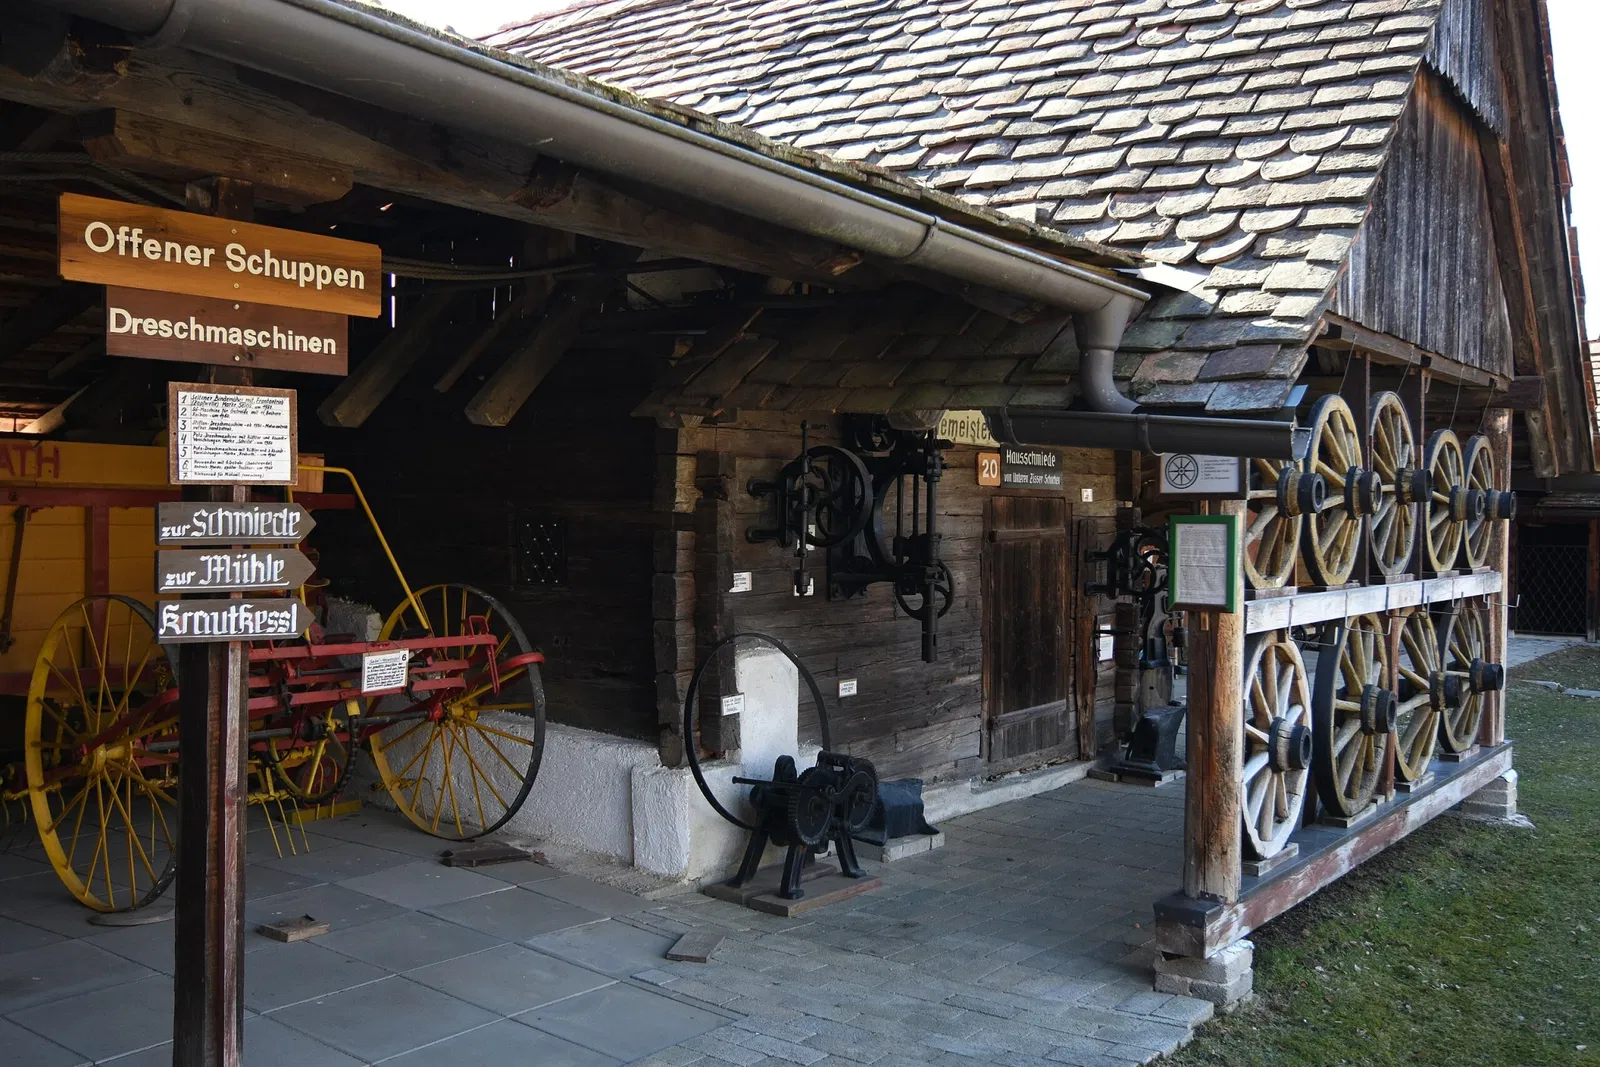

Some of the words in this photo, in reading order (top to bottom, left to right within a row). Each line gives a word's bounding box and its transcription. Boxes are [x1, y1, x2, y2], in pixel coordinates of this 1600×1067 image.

[84, 221, 216, 267] Offener
[226, 243, 366, 290] Schuppen
[109, 307, 337, 354] Dreschmaschinen
[181, 395, 187, 403] 1
[180, 420, 186, 430] 3
[180, 434, 186, 444] 4
[180, 447, 188, 457] 5
[1006, 450, 1056, 467] Hausschmiede
[982, 459, 998, 479] 20
[161, 523, 191, 538] zur
[190, 507, 301, 538] Schmiede
[165, 571, 196, 586] zur
[199, 554, 285, 586] Mühle
[159, 603, 298, 636] Krautkessl
